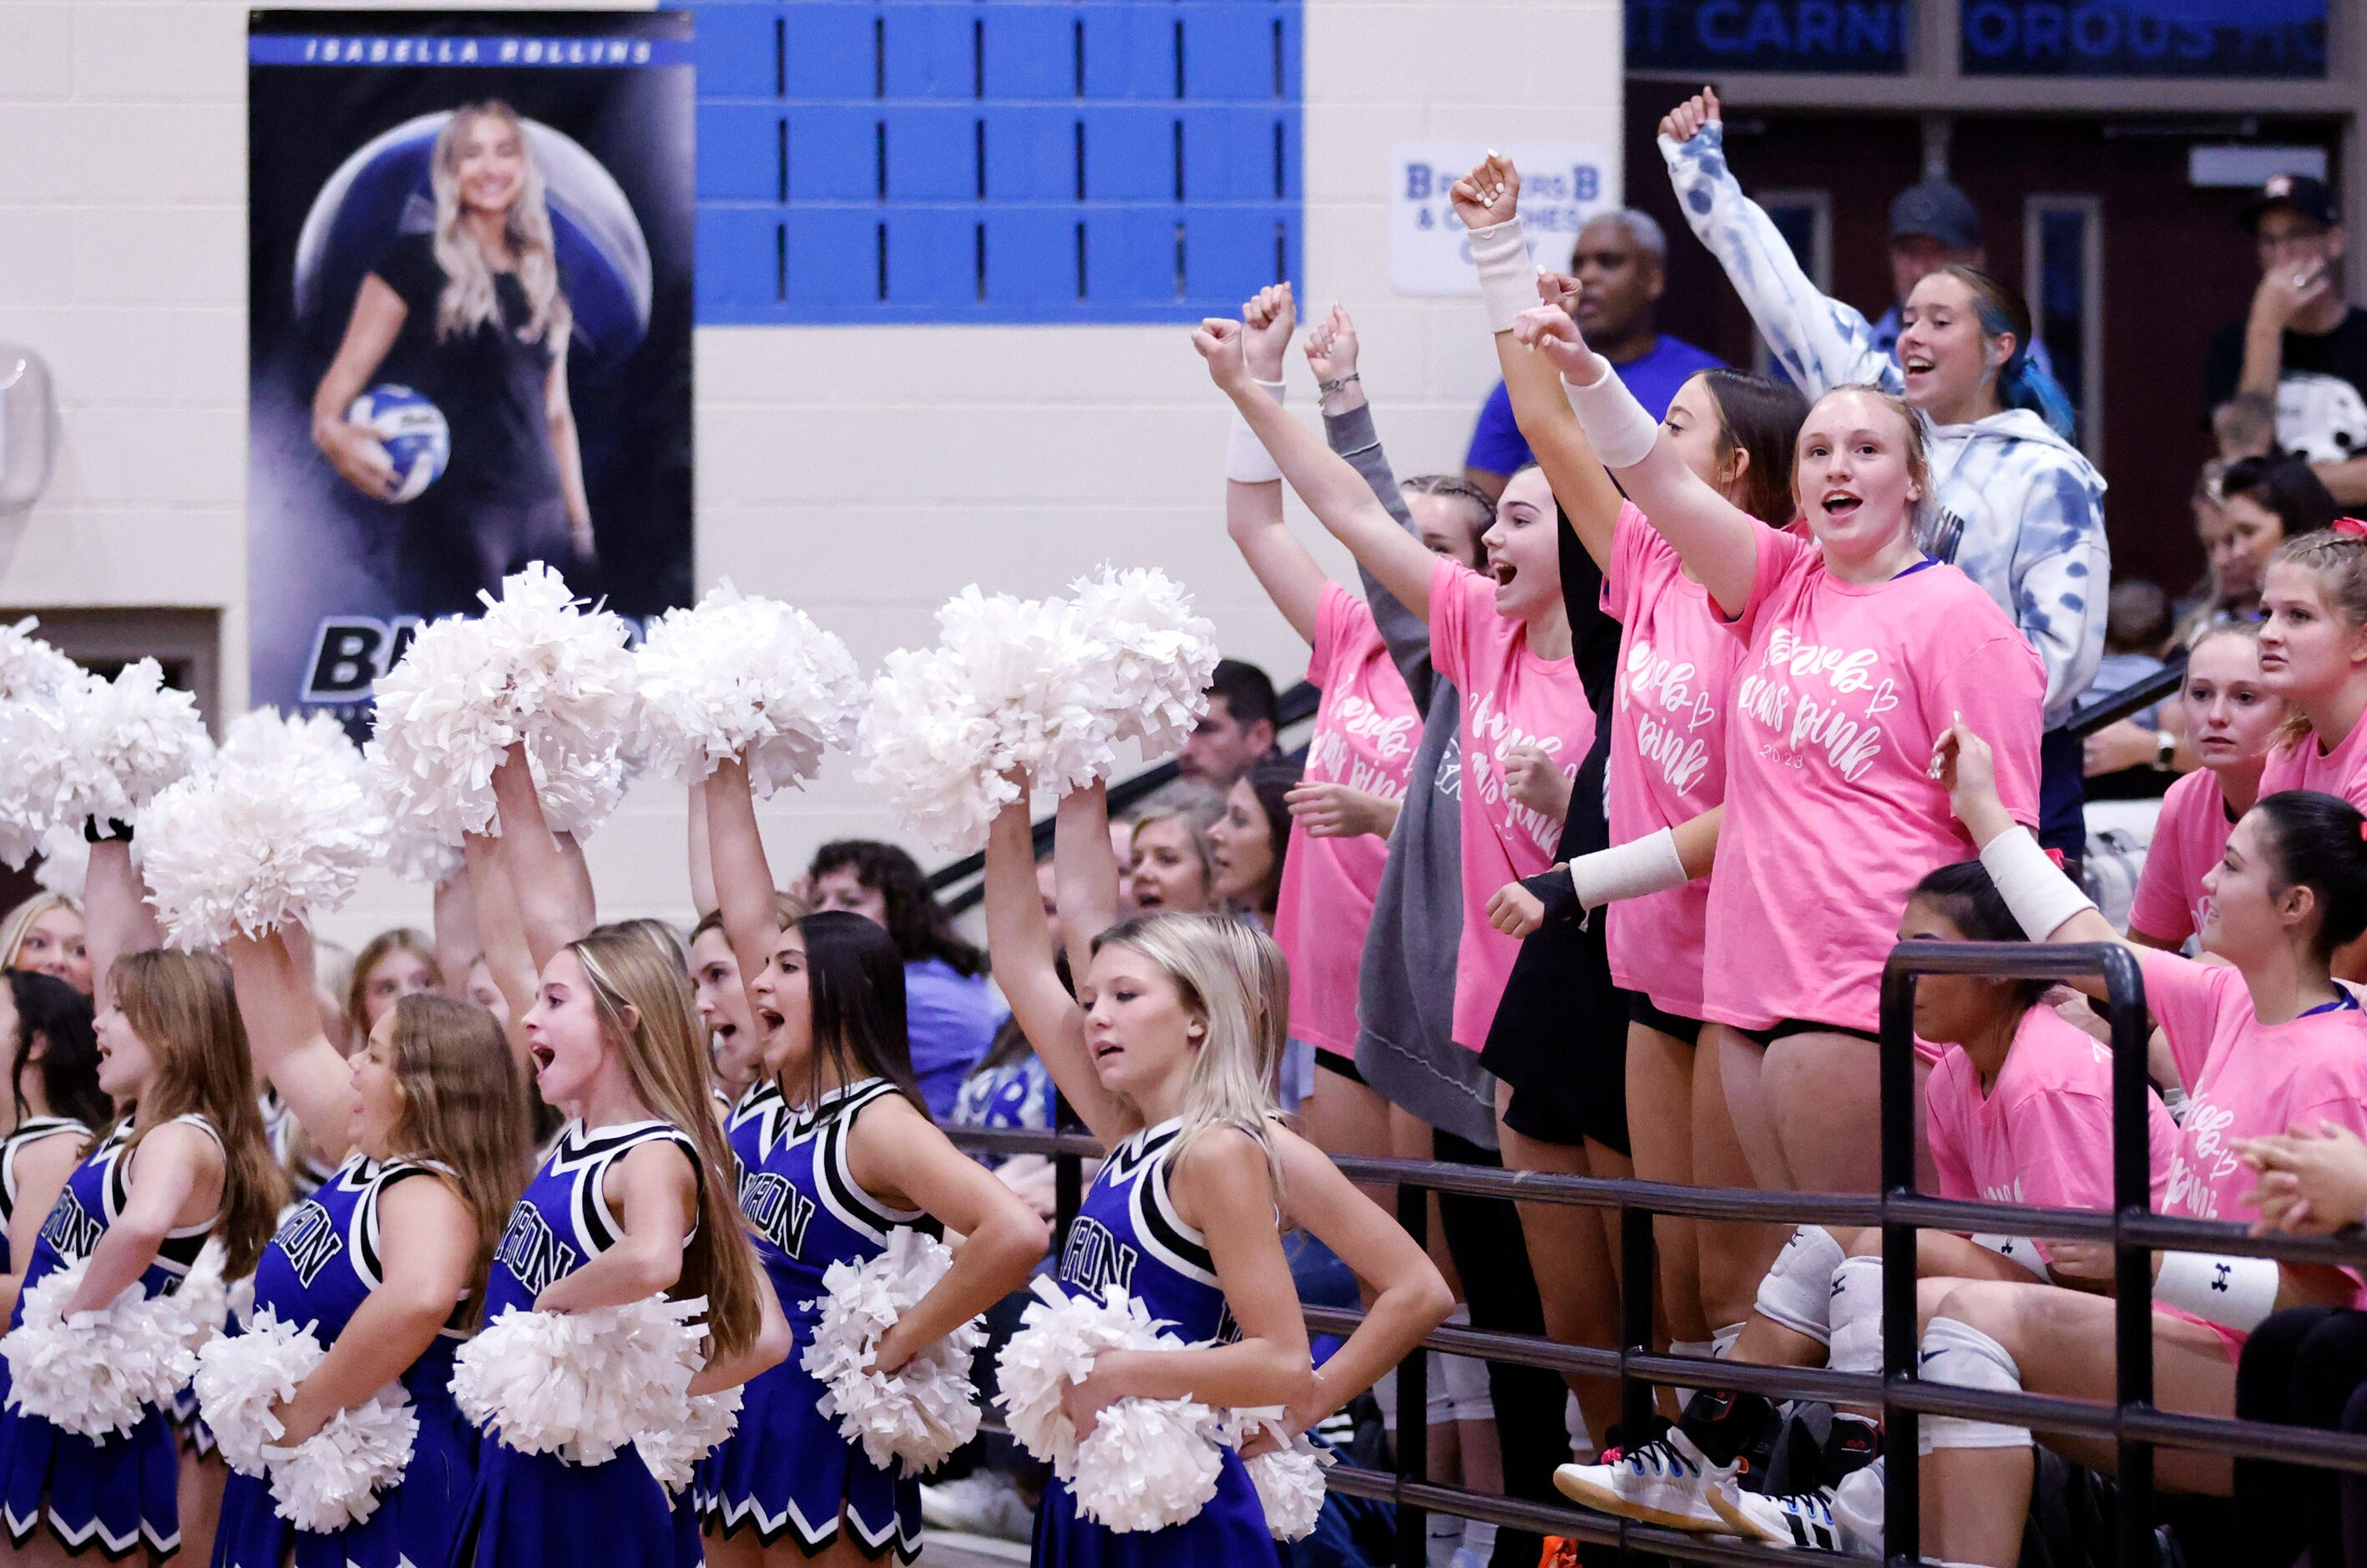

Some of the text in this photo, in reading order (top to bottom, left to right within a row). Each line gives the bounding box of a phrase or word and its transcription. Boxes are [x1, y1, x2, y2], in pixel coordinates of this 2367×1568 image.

[304, 38, 653, 64] ISABELLA ROLLINS
[1790, 694, 1882, 783] pink
[1759, 744, 1804, 770] 2023
